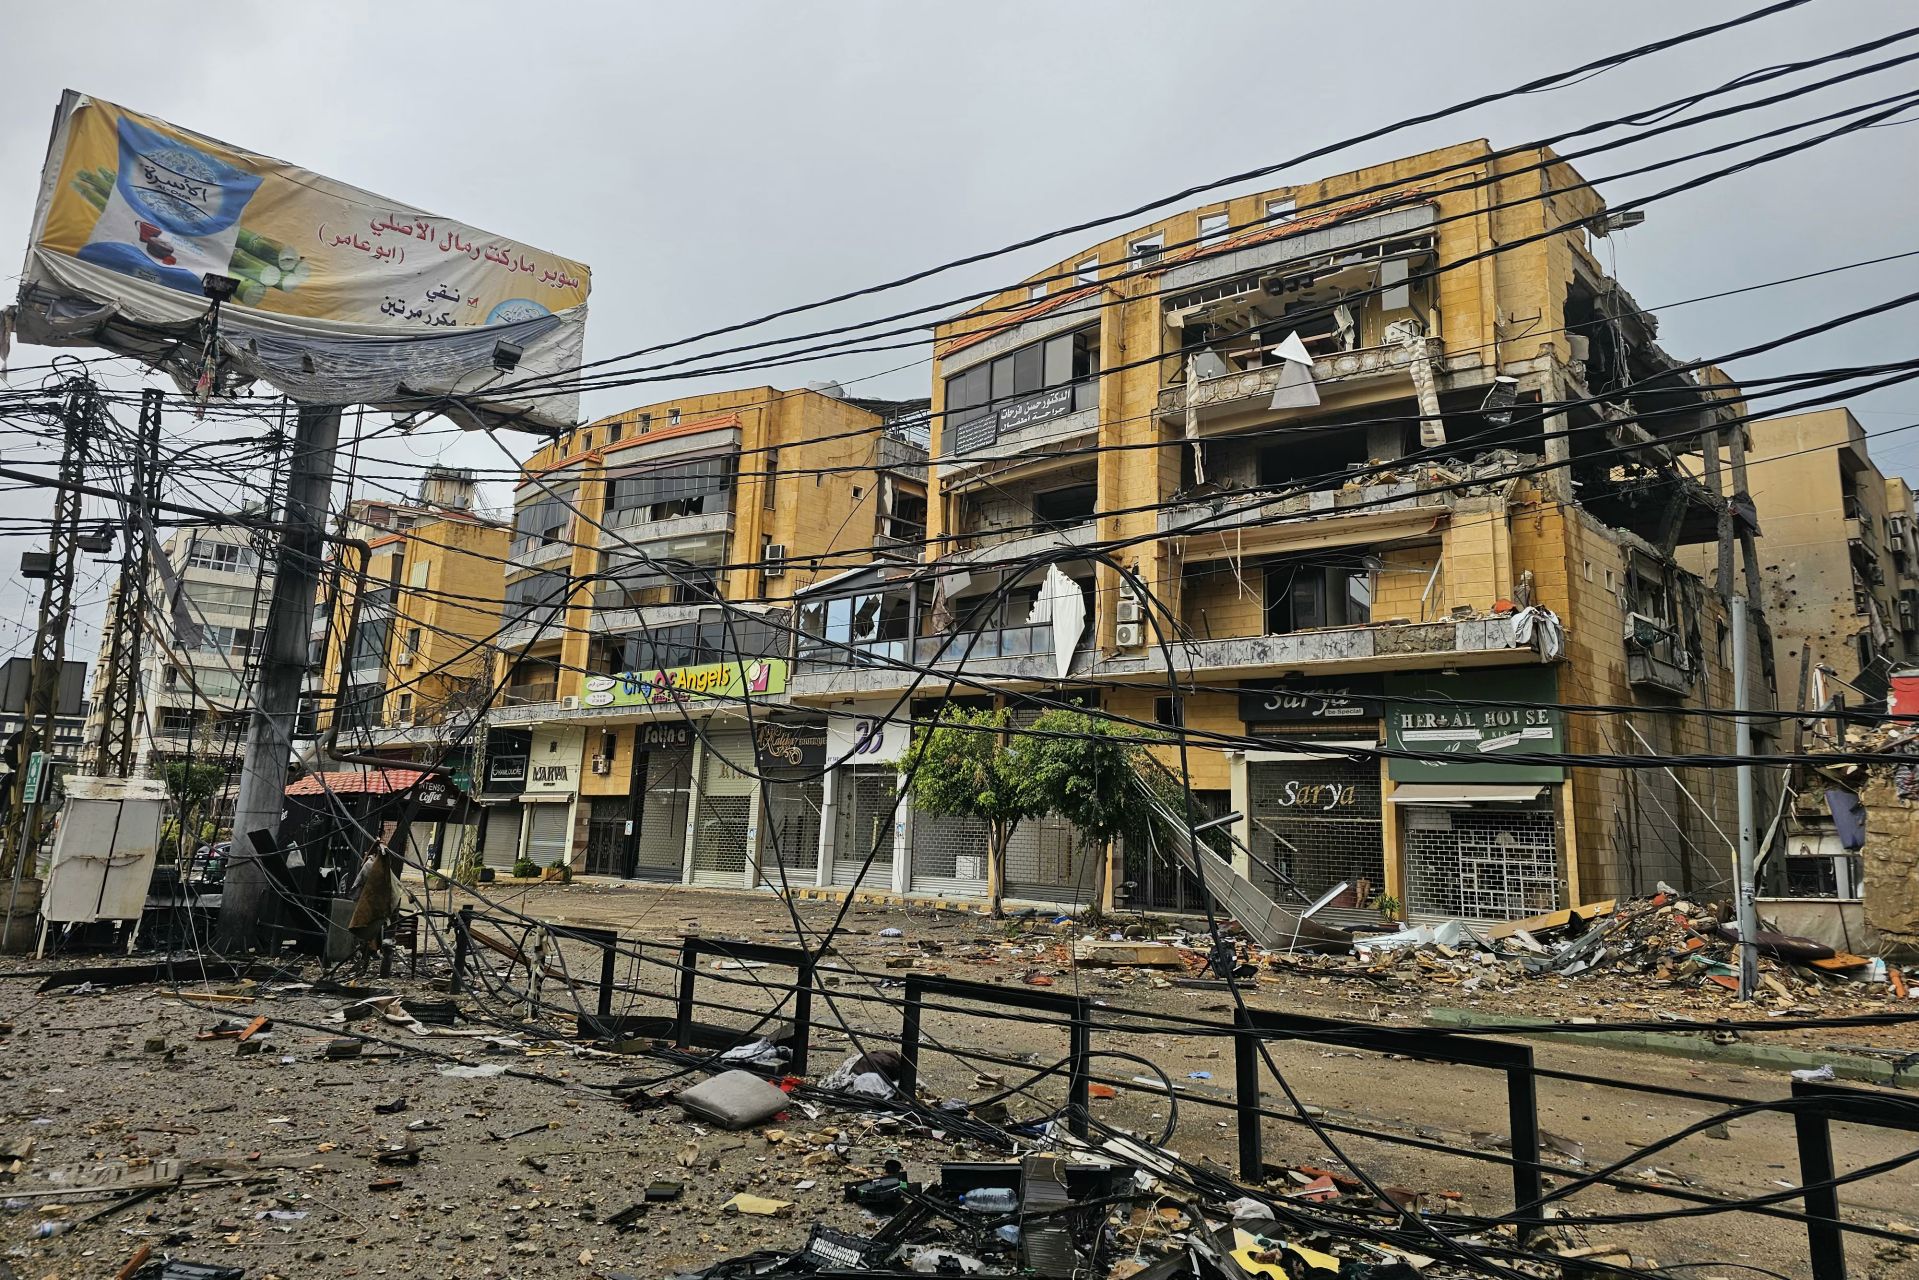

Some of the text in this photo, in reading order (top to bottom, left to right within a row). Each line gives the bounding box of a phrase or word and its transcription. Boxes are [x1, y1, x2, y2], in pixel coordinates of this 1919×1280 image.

[144, 164, 208, 203] الأسرة
[369, 211, 579, 288] سوبر ماركت رمال الأصلي
[425, 283, 461, 303] نقي
[380, 295, 423, 320] مرتين
[678, 663, 731, 692] Angels
[419, 782, 446, 793] INTENSO
[419, 791, 442, 804] Coffee
[1278, 781, 1356, 811] Sarya
